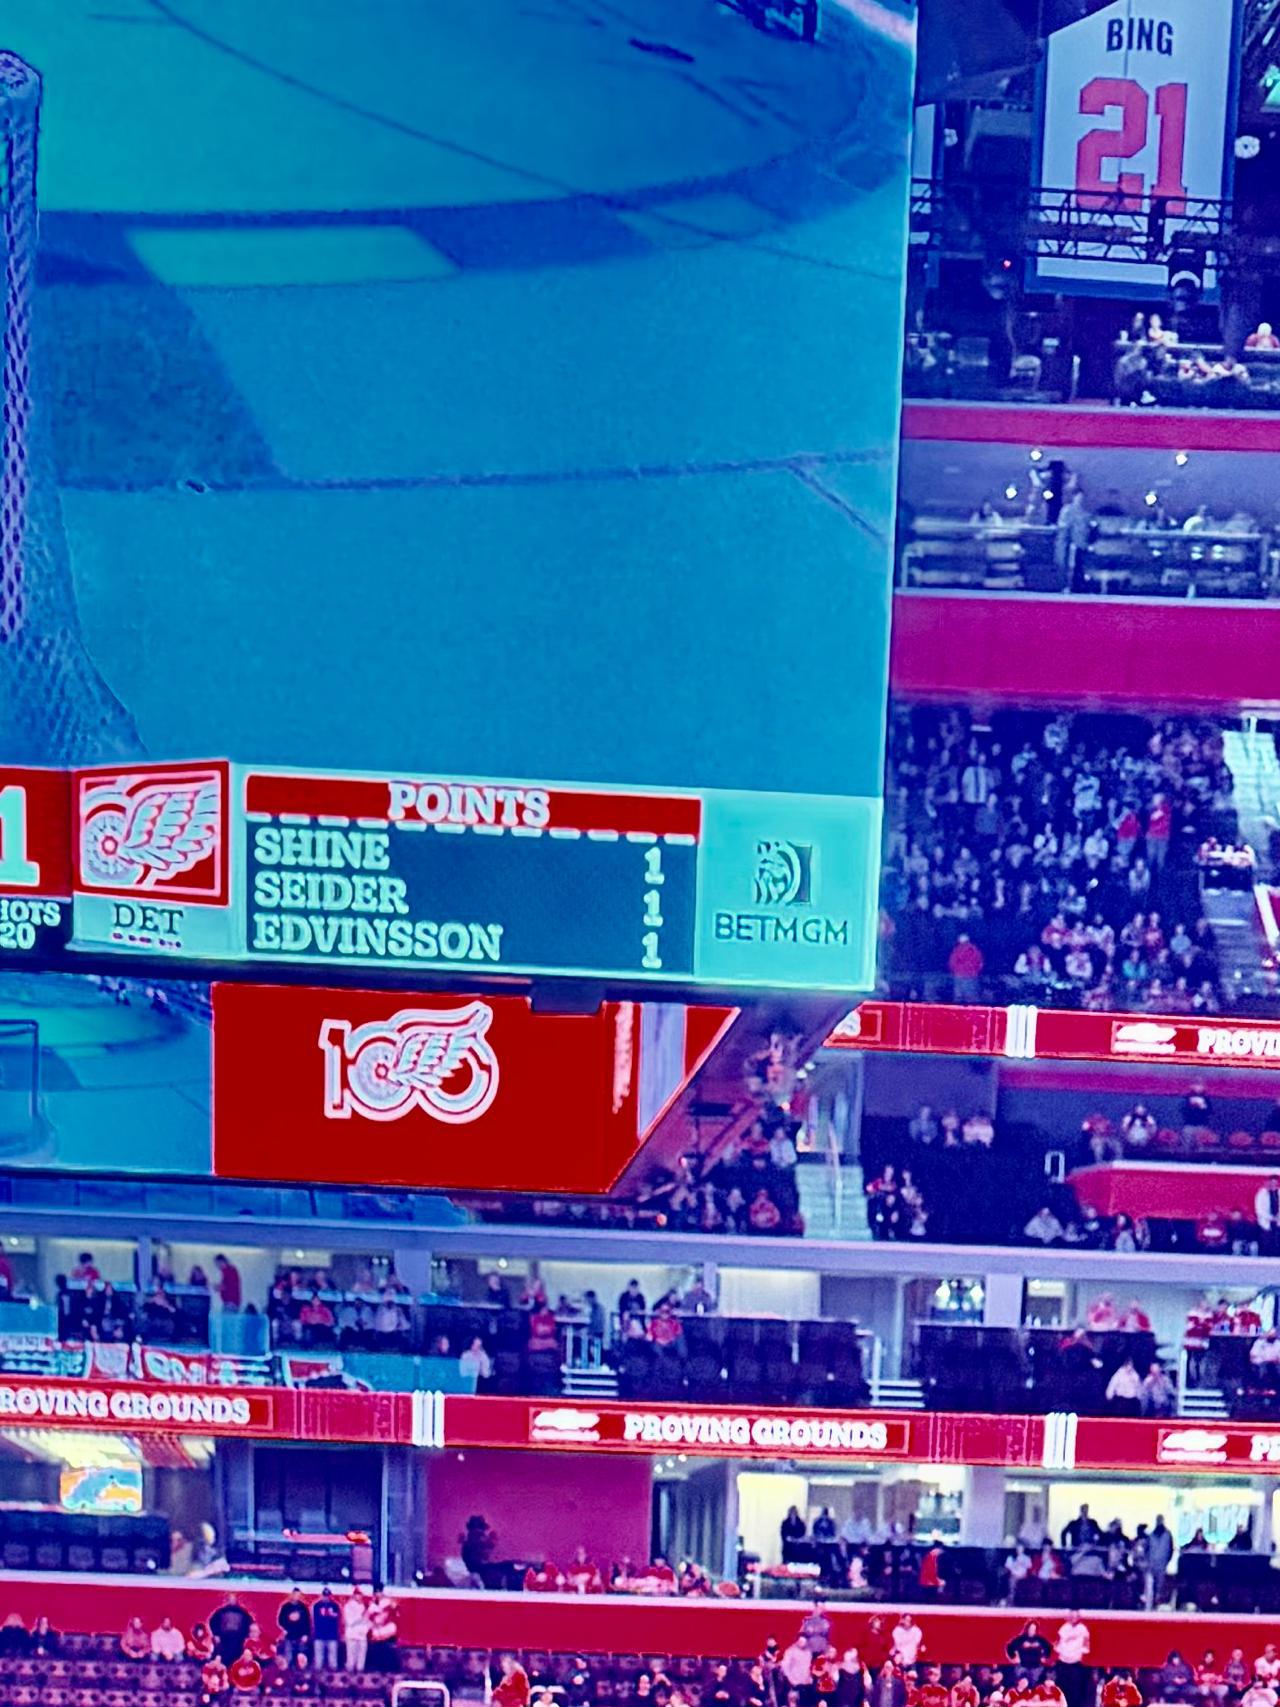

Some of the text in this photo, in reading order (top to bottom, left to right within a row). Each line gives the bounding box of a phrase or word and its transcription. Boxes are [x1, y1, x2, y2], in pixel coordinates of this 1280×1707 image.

[1106, 17, 1174, 56] BING
[1076, 77, 1189, 215] 21
[388, 780, 551, 828] POINTS
[254, 828, 665, 885] SHINE 1
[113, 902, 183, 935] DET
[254, 871, 664, 927] SEIDER 1
[252, 912, 663, 969] EDVINSSON 1
[714, 913, 848, 945] BETMGM
[110, 1393, 251, 1425] GROUNDS
[624, 1413, 888, 1450] PROVING GROUNDS
